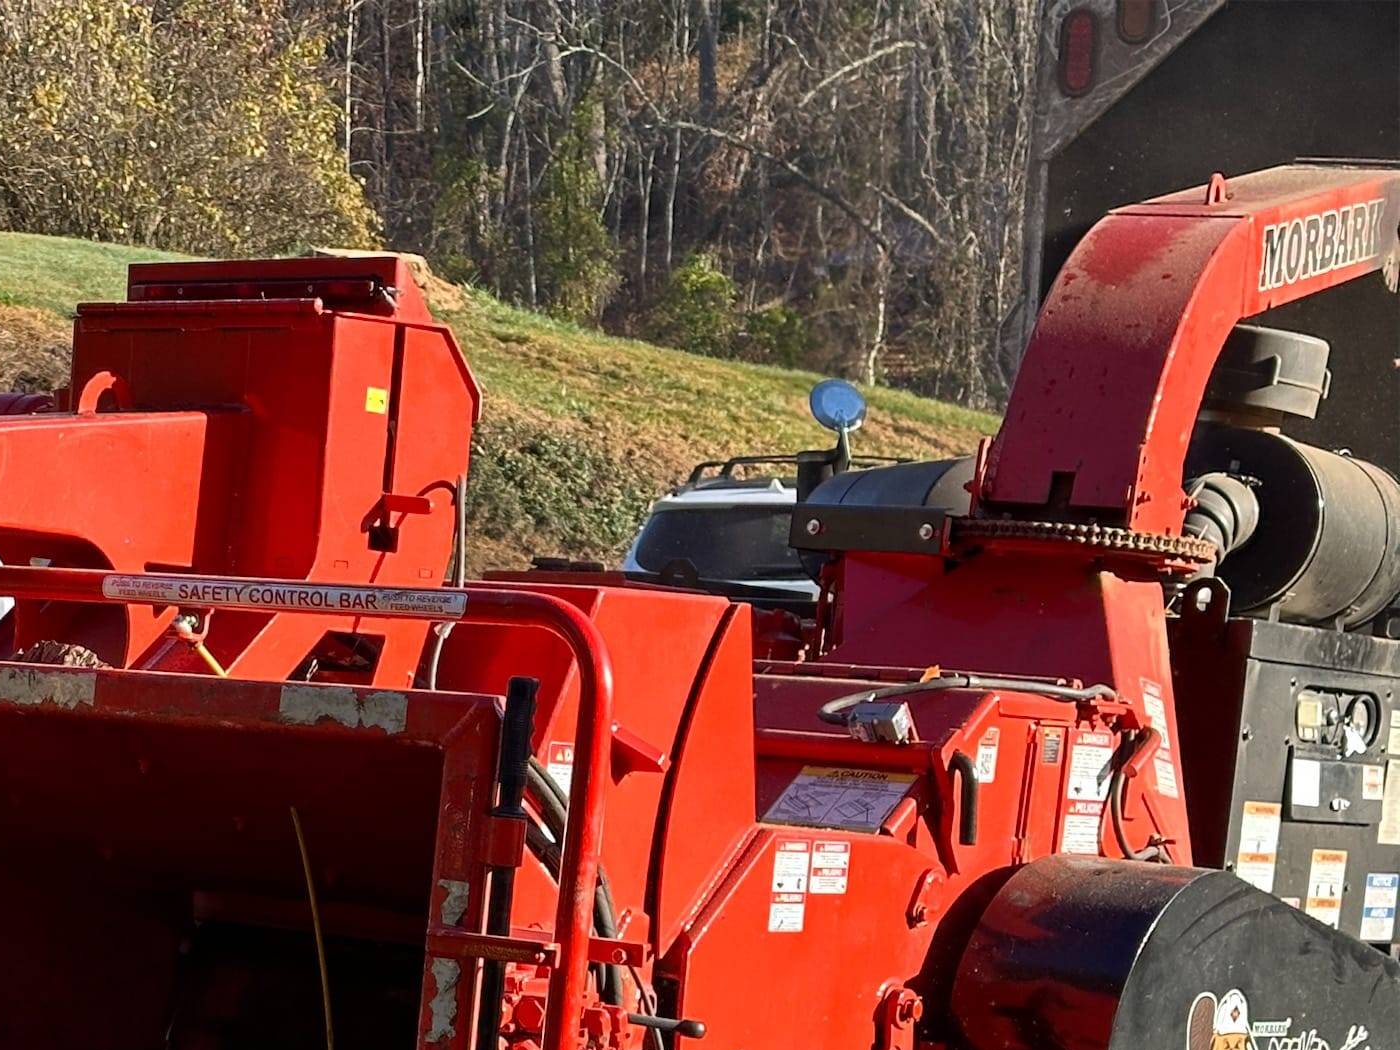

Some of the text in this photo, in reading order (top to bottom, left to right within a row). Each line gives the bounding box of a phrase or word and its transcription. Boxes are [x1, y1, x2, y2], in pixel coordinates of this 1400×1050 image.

[1258, 198, 1385, 292] MORBARK
[178, 584, 378, 610] SAFETY CONTROL BAR
[840, 770, 888, 781] CAUTION
